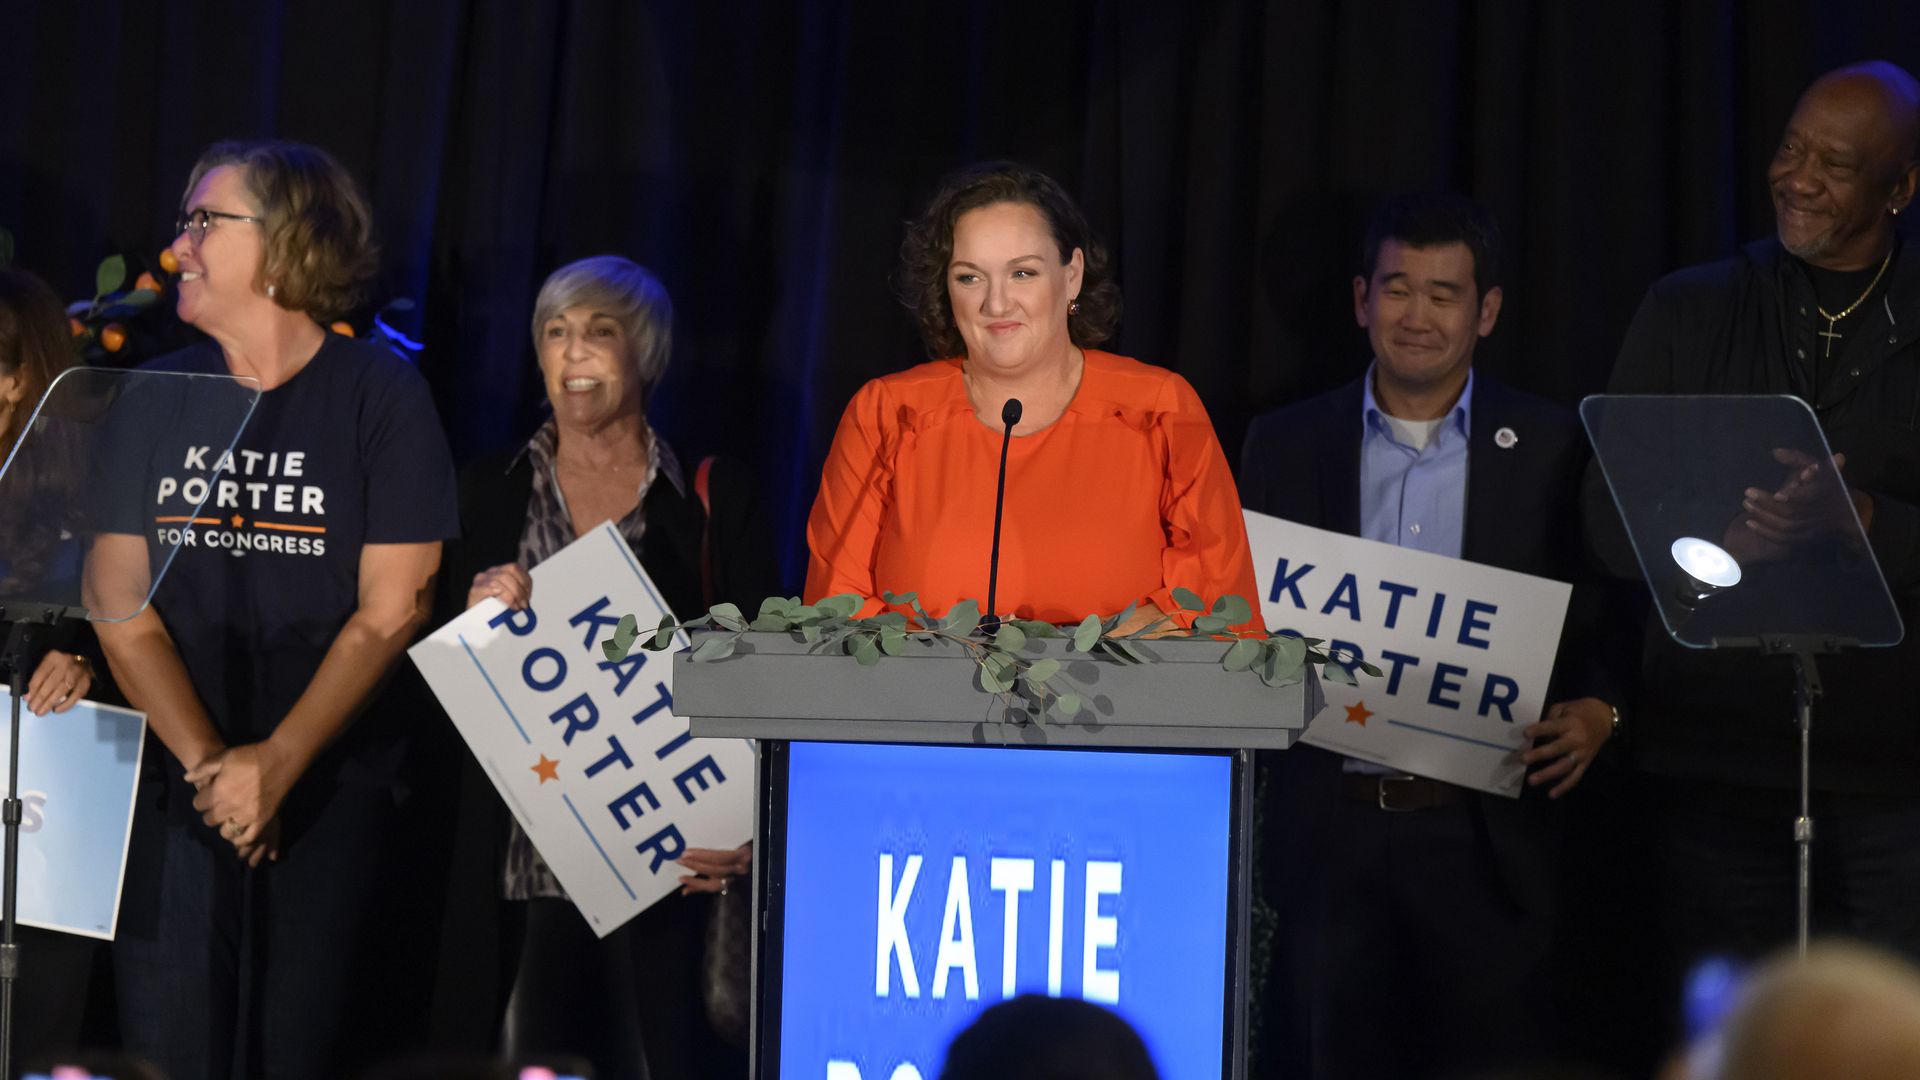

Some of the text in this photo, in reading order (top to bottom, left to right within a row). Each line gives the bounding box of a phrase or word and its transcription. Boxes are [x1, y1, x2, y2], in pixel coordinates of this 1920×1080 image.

[157, 477, 325, 515] PORTER
[184, 446, 306, 477] KATIE
[157, 528, 326, 556] FOR CONGRESS
[1268, 557, 1498, 650] KATIE
[568, 596, 727, 805] KATIE
[1273, 628, 1520, 724] RTER
[488, 606, 687, 876] PORTER
[876, 853, 1123, 1004] KATIE
